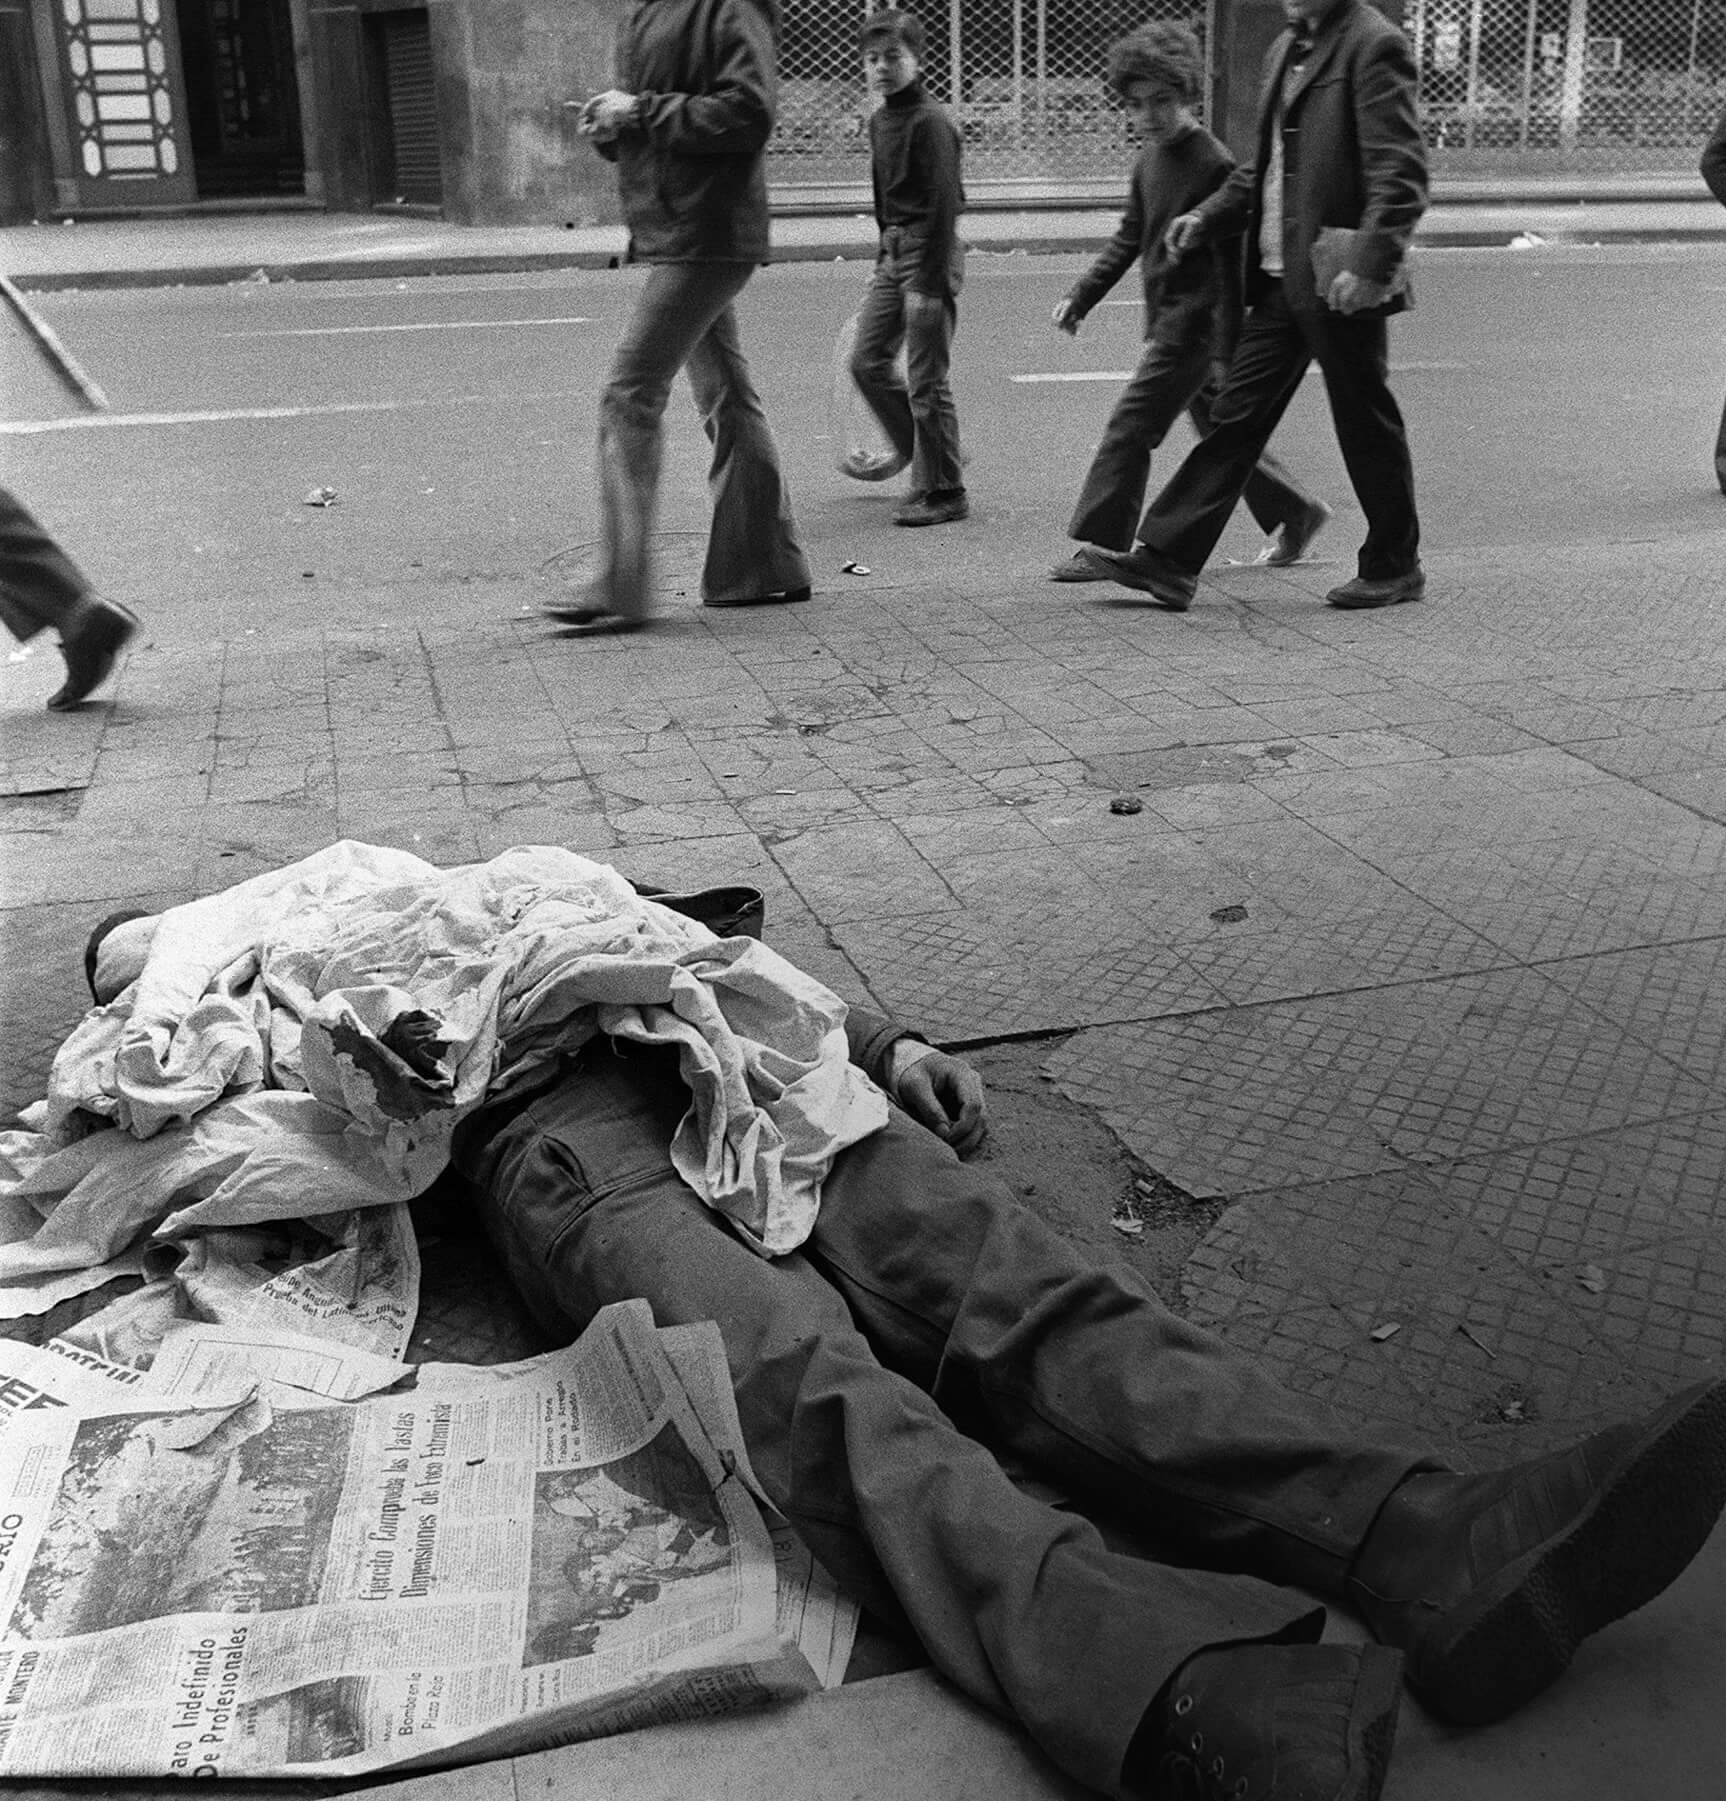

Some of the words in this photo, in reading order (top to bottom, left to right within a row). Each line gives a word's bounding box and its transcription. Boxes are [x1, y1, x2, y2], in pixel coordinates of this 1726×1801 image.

[398, 1514, 437, 1598] Dimensiones
[171, 1638, 216, 1729] Indefinido
[199, 1627, 248, 1743] Profesionales
[164, 1741, 192, 1778] aro
[194, 1753, 220, 1778] De
